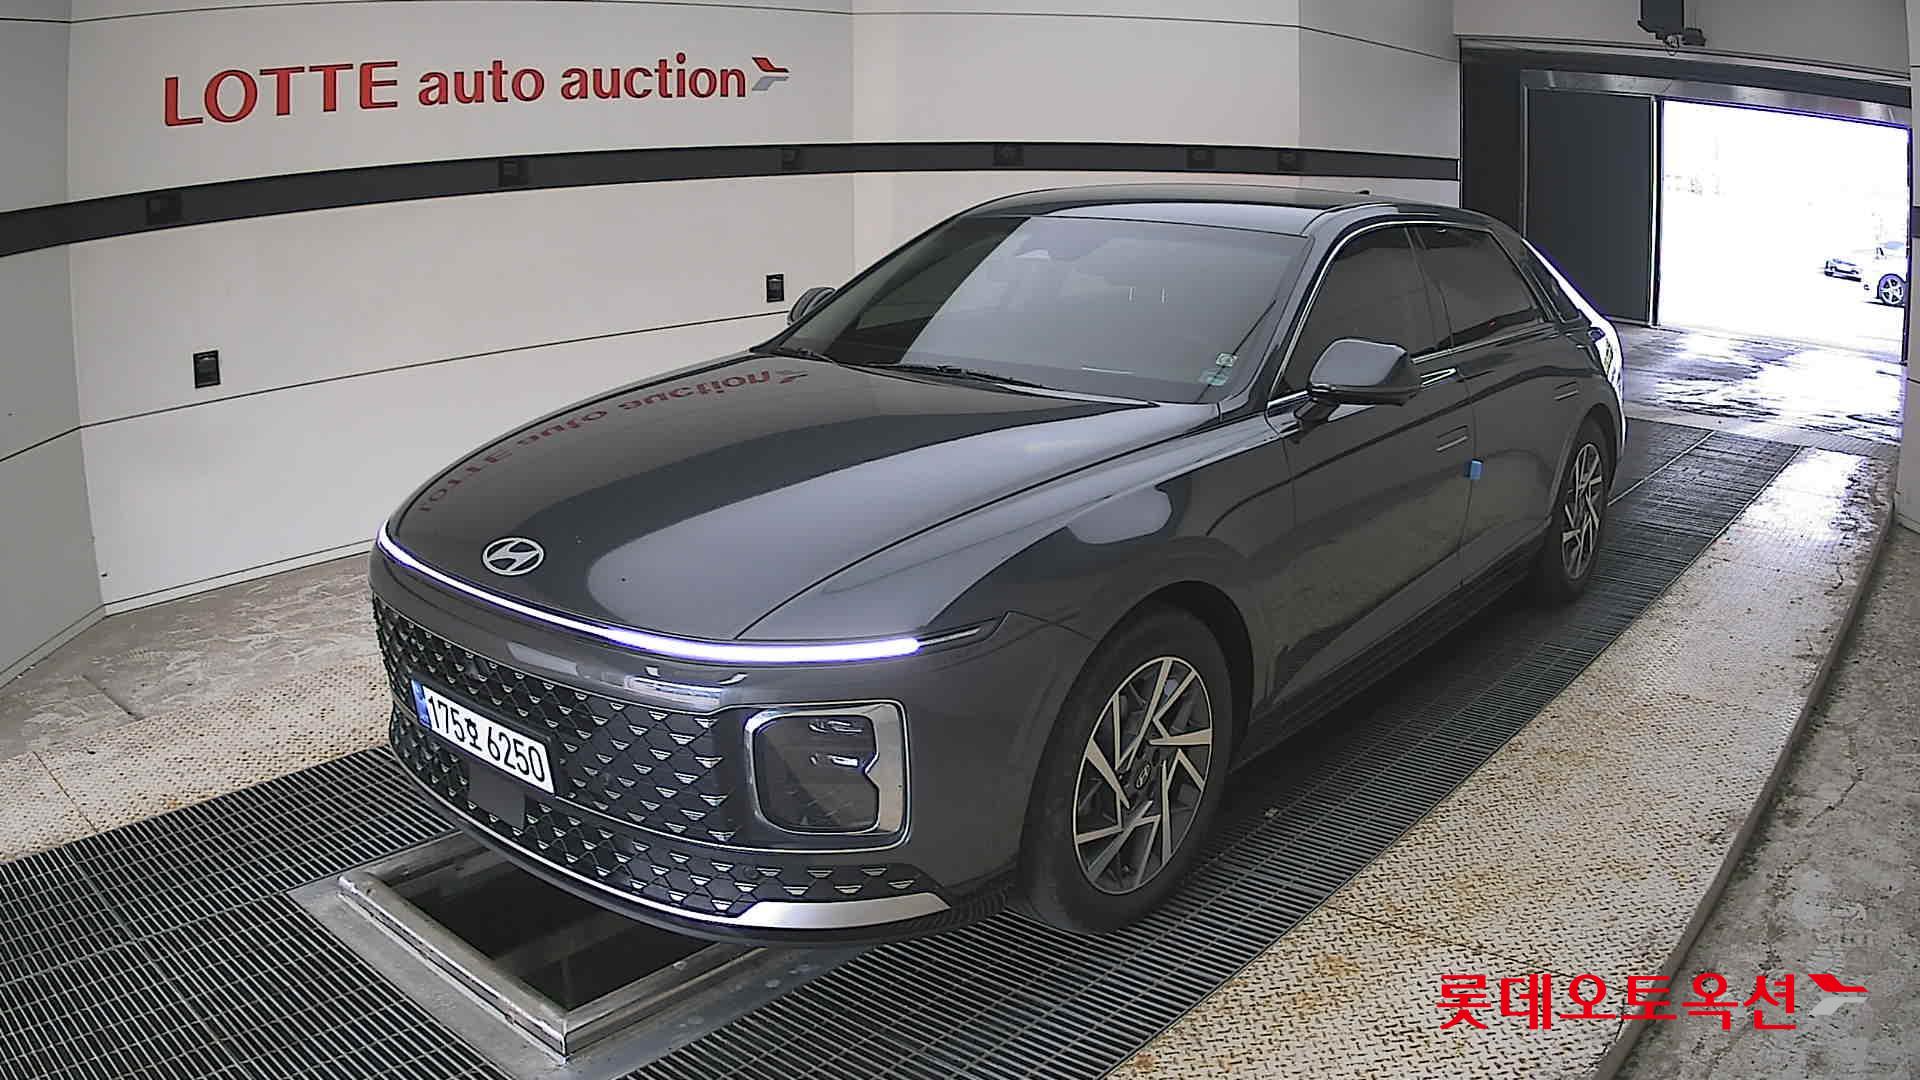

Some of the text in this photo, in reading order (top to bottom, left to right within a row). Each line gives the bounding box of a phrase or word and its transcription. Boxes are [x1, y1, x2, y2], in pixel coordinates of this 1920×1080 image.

[164, 52, 747, 127] LOTTE auto auction
[428, 696, 545, 782] 175호 6250
